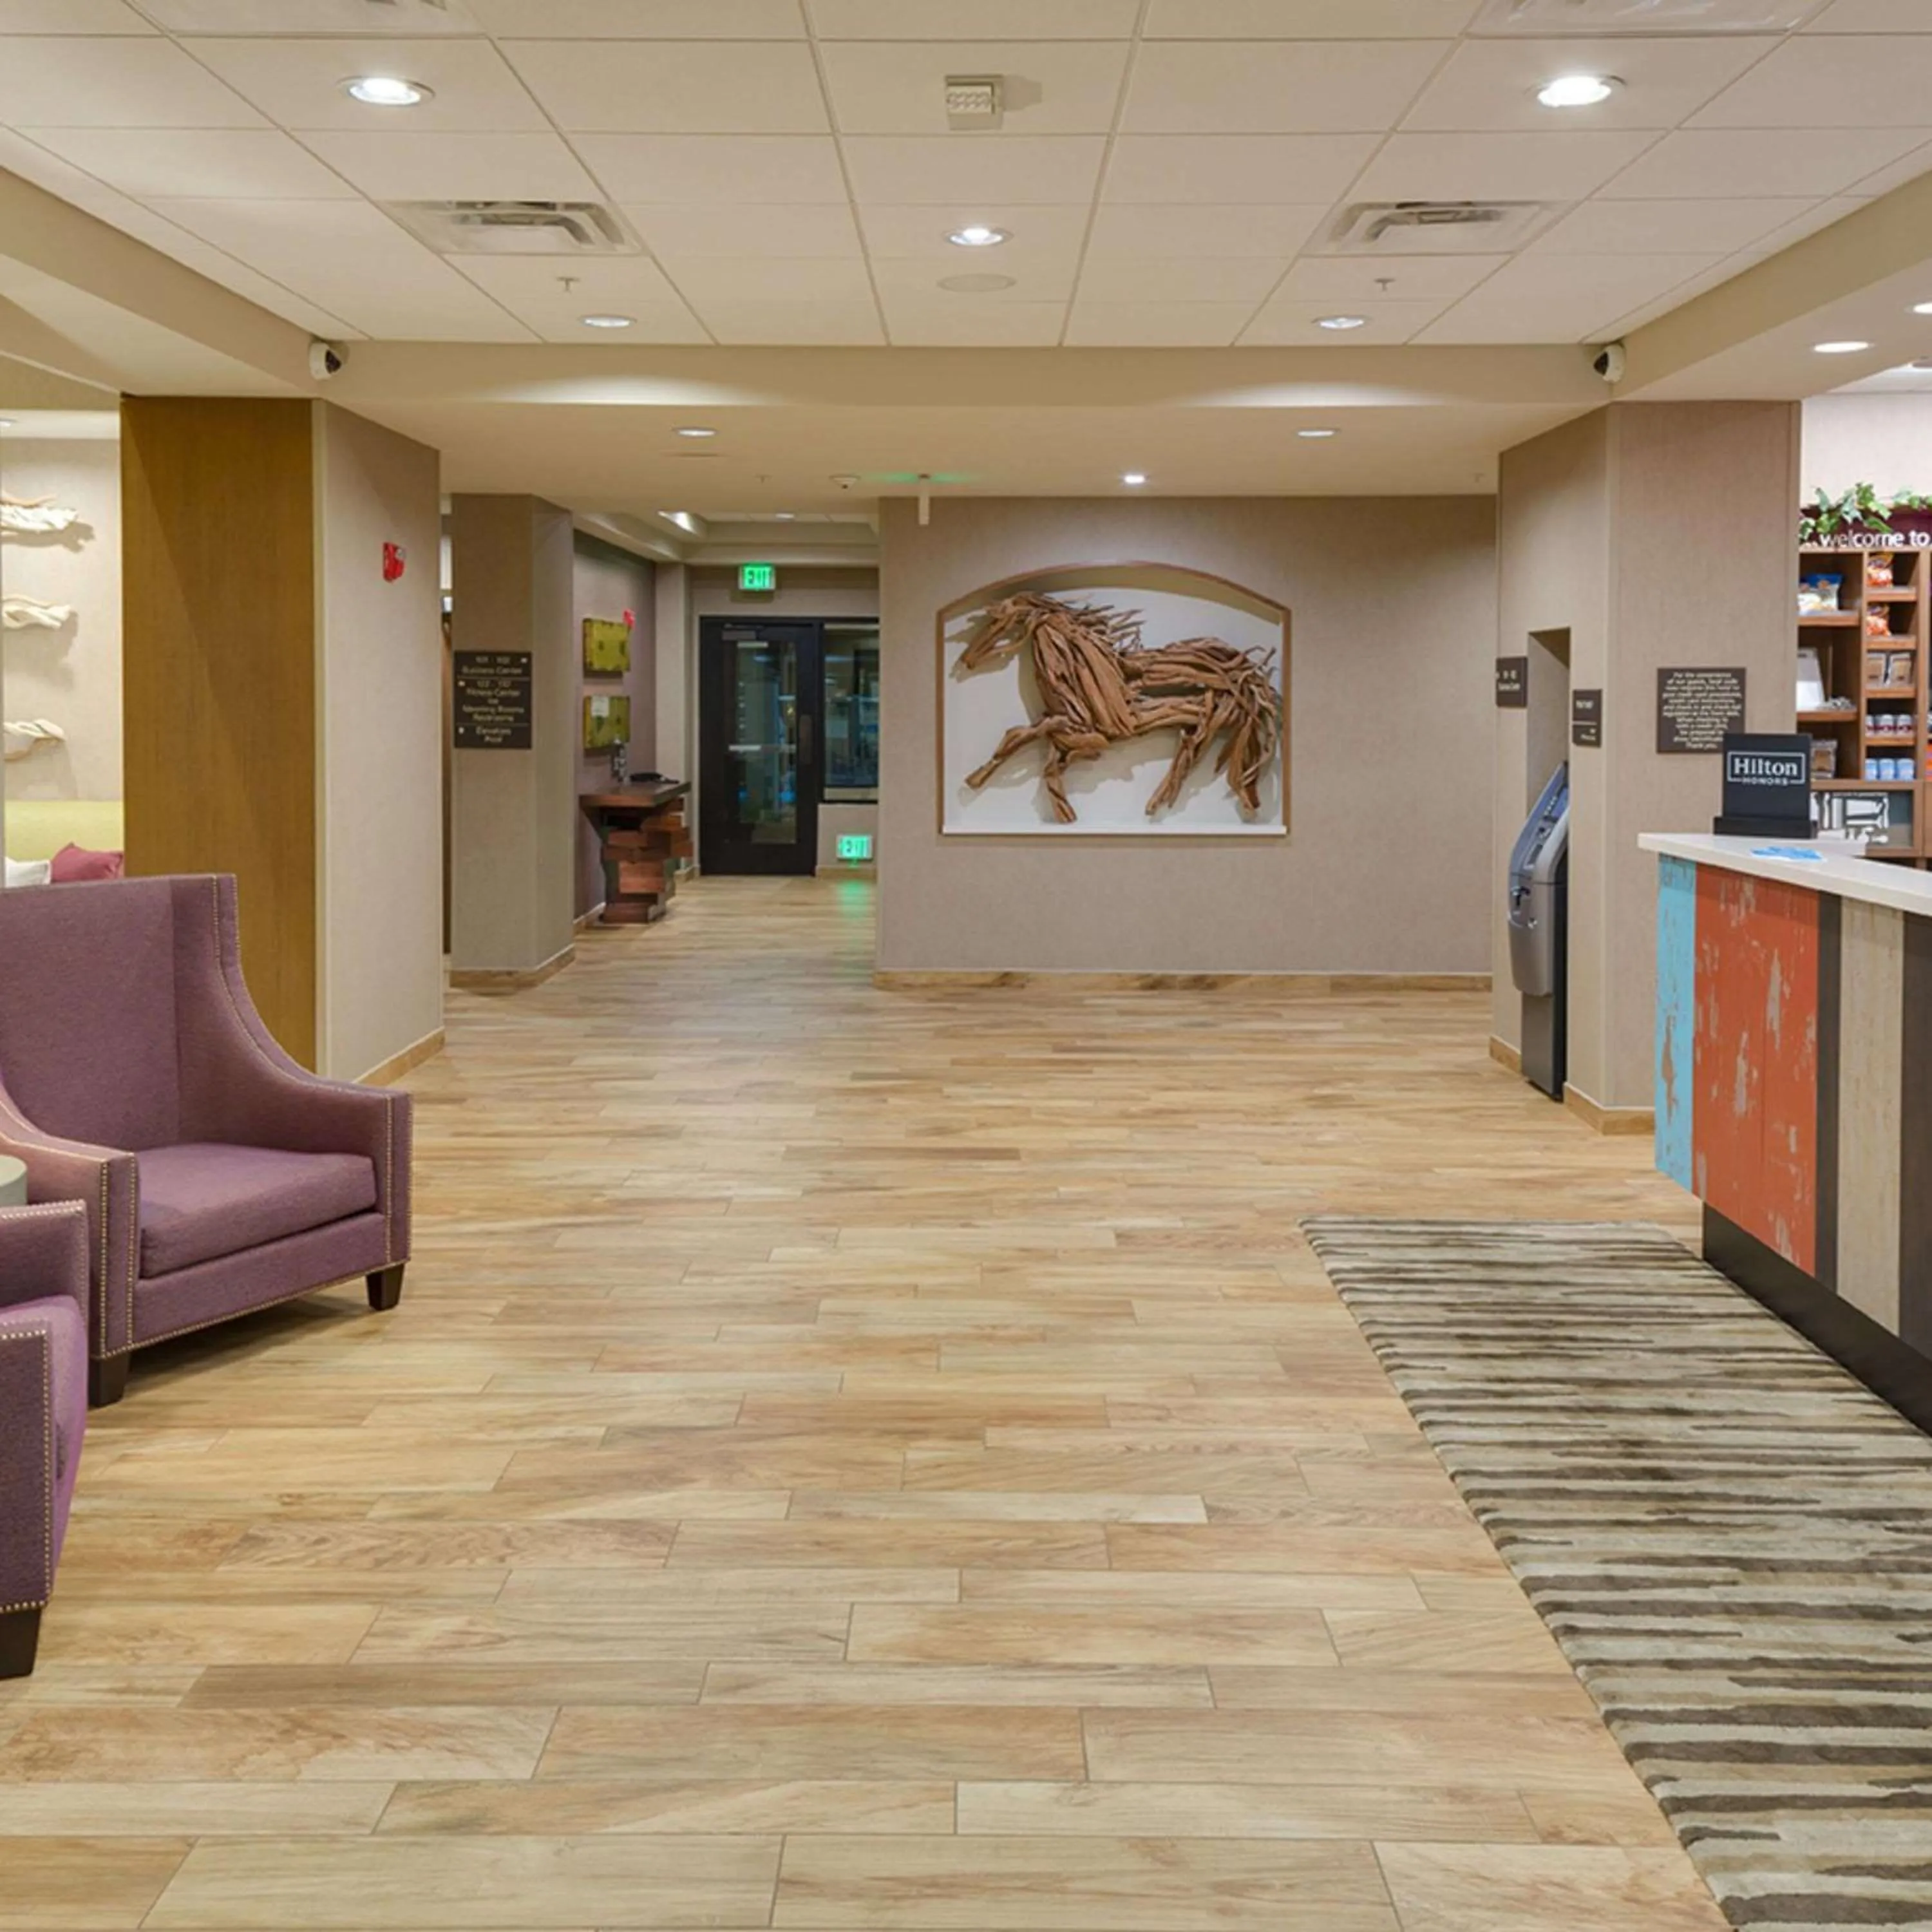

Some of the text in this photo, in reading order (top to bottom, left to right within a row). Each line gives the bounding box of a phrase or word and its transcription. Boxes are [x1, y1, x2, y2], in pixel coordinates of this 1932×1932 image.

[1819, 529, 1930, 547] welcome to
[743, 567, 772, 588] EXIT
[496, 665, 522, 674] Center
[494, 688, 521, 697] Center
[462, 704, 496, 714] Meeting
[475, 726, 512, 735] Elevators
[1734, 757, 1798, 776] Hilton
[1742, 777, 1789, 786] HONORS
